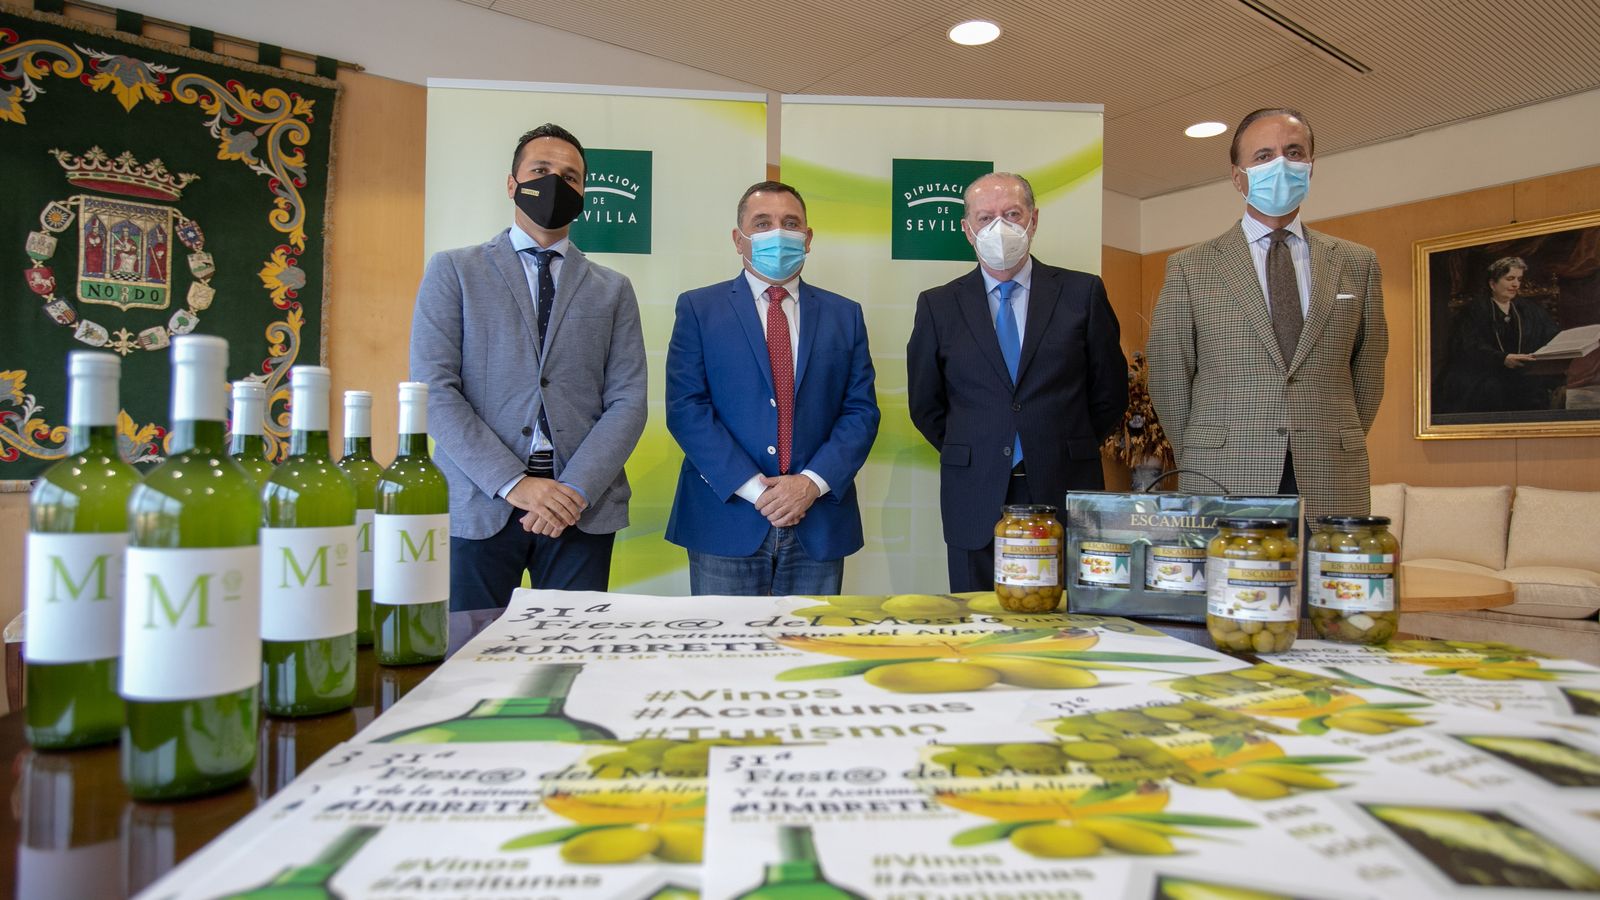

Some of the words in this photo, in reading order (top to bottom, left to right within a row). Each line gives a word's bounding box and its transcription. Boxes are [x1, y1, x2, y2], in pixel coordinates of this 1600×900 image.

[586, 173, 640, 192] TACION
[904, 183, 963, 200] DIPUTACI
[593, 197, 605, 205] DE
[573, 210, 637, 224] VILLA
[937, 206, 949, 214] DE
[906, 219, 965, 232] SEVIL
[529, 618, 724, 631] Fiest@
[745, 615, 824, 628] del
[841, 615, 1001, 627] Mosto
[541, 633, 578, 641] de
[587, 633, 618, 641] la
[630, 632, 767, 641] Aceituna
[480, 642, 784, 655] #UMBRETE
[644, 688, 843, 703] #Vinos
[633, 702, 974, 720] #Aceitunas
[633, 723, 947, 741] #Turismo
[539, 763, 606, 780] del
[901, 763, 958, 779] del
[322, 800, 541, 813] #UMBRETE
